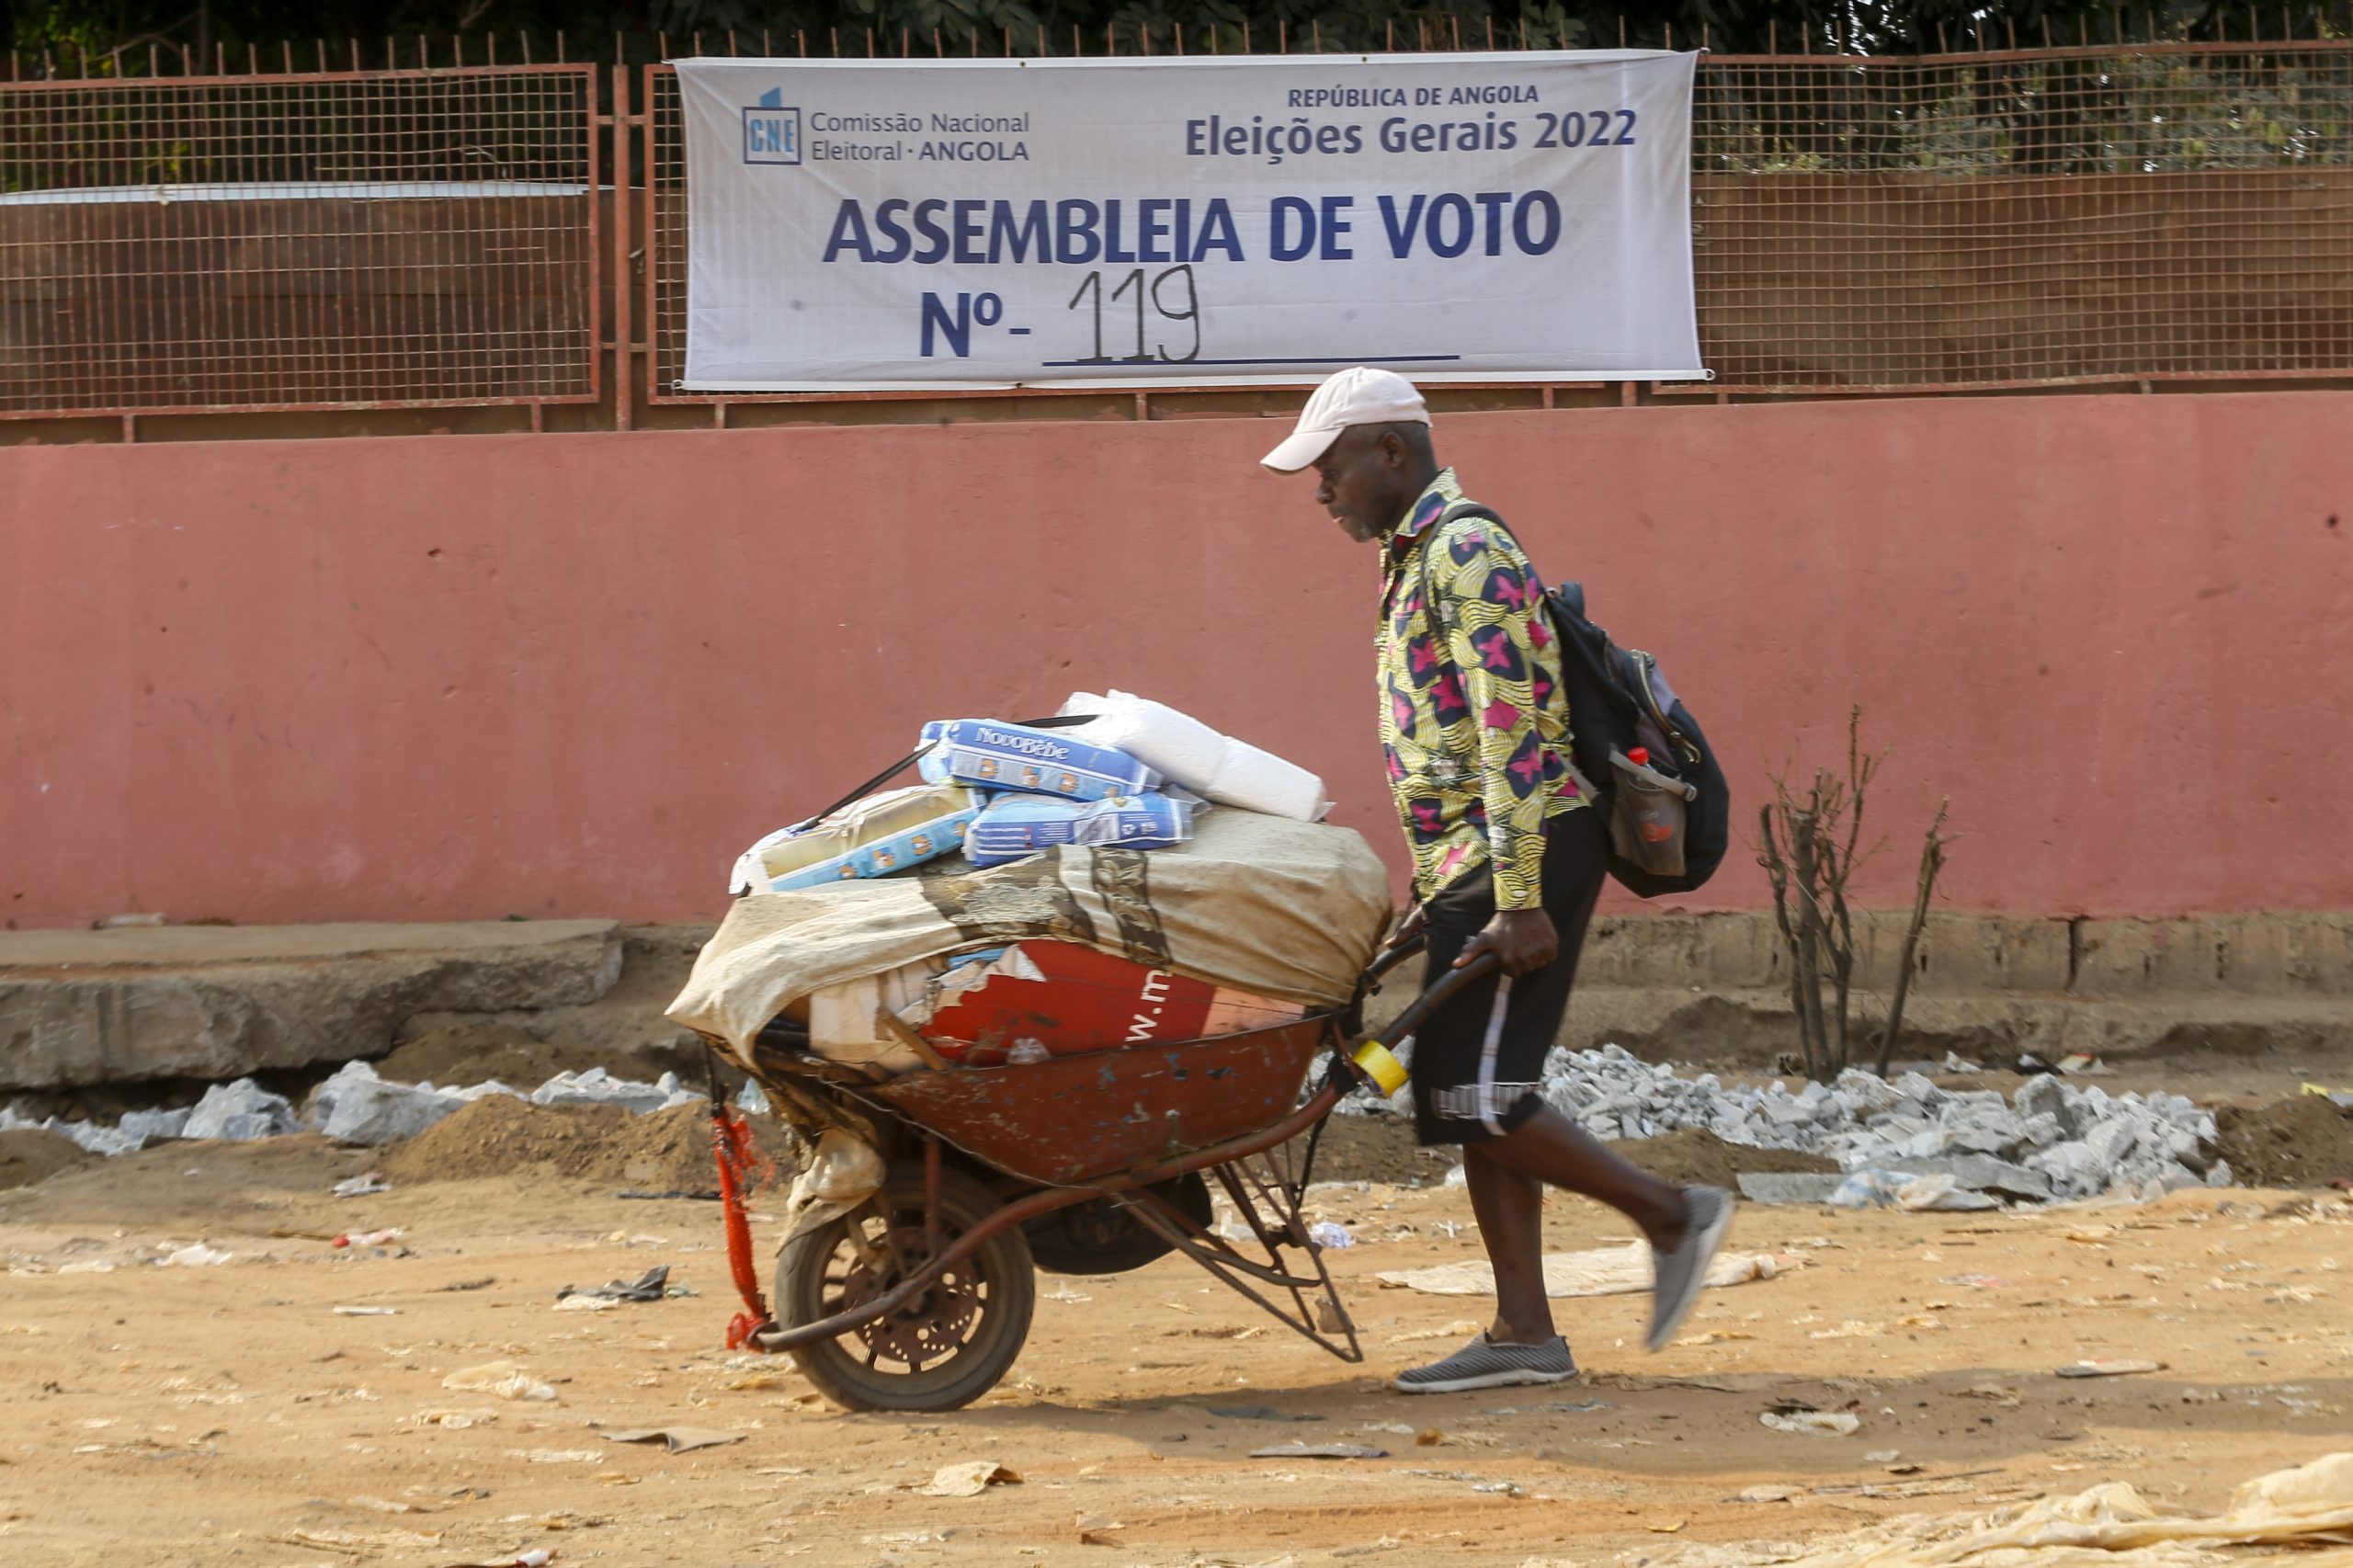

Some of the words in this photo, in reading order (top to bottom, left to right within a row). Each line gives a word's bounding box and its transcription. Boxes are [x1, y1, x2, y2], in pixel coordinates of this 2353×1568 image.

[1289, 84, 1407, 108] REPÚBLICA
[1415, 87, 1442, 106] DE
[1449, 85, 1540, 105] ANGOLA
[749, 118, 795, 153] CNE
[811, 111, 923, 133] Comissão
[931, 111, 1029, 133] Nacional
[1186, 114, 1363, 165] Eleições
[1380, 110, 1518, 154] Gerais
[1532, 108, 1637, 149] 2022
[811, 140, 903, 162] Eleitoral
[918, 141, 1030, 162] ANGOLA
[823, 198, 1245, 265] ASSEMBLEIA
[1269, 195, 1354, 262] DE
[1376, 188, 1562, 260] VOTO
[1068, 263, 1200, 362] 119
